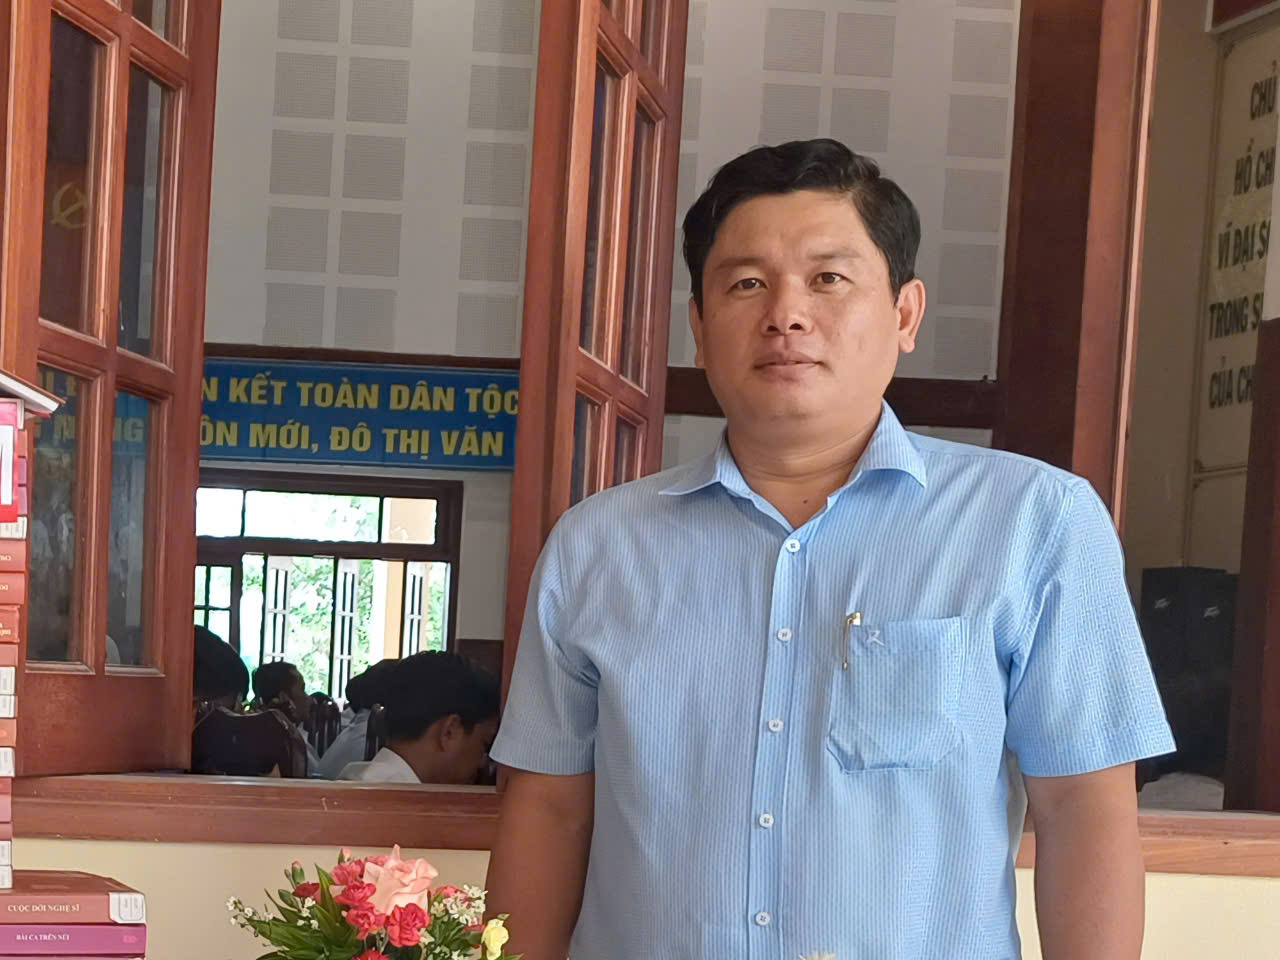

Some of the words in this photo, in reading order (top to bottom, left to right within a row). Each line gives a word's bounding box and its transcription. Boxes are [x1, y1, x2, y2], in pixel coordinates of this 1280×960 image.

[1255, 147, 1276, 189] CH
[1208, 296, 1249, 341] TRONG
[228, 371, 287, 405] KẾT
[297, 377, 379, 409] TOÀN
[389, 381, 455, 412] DÂN
[465, 384, 519, 418] TỘC
[249, 419, 319, 453] MỚI,
[329, 422, 371, 452] ĐÔ
[382, 428, 431, 460] THỊ
[440, 425, 504, 456] VĂN
